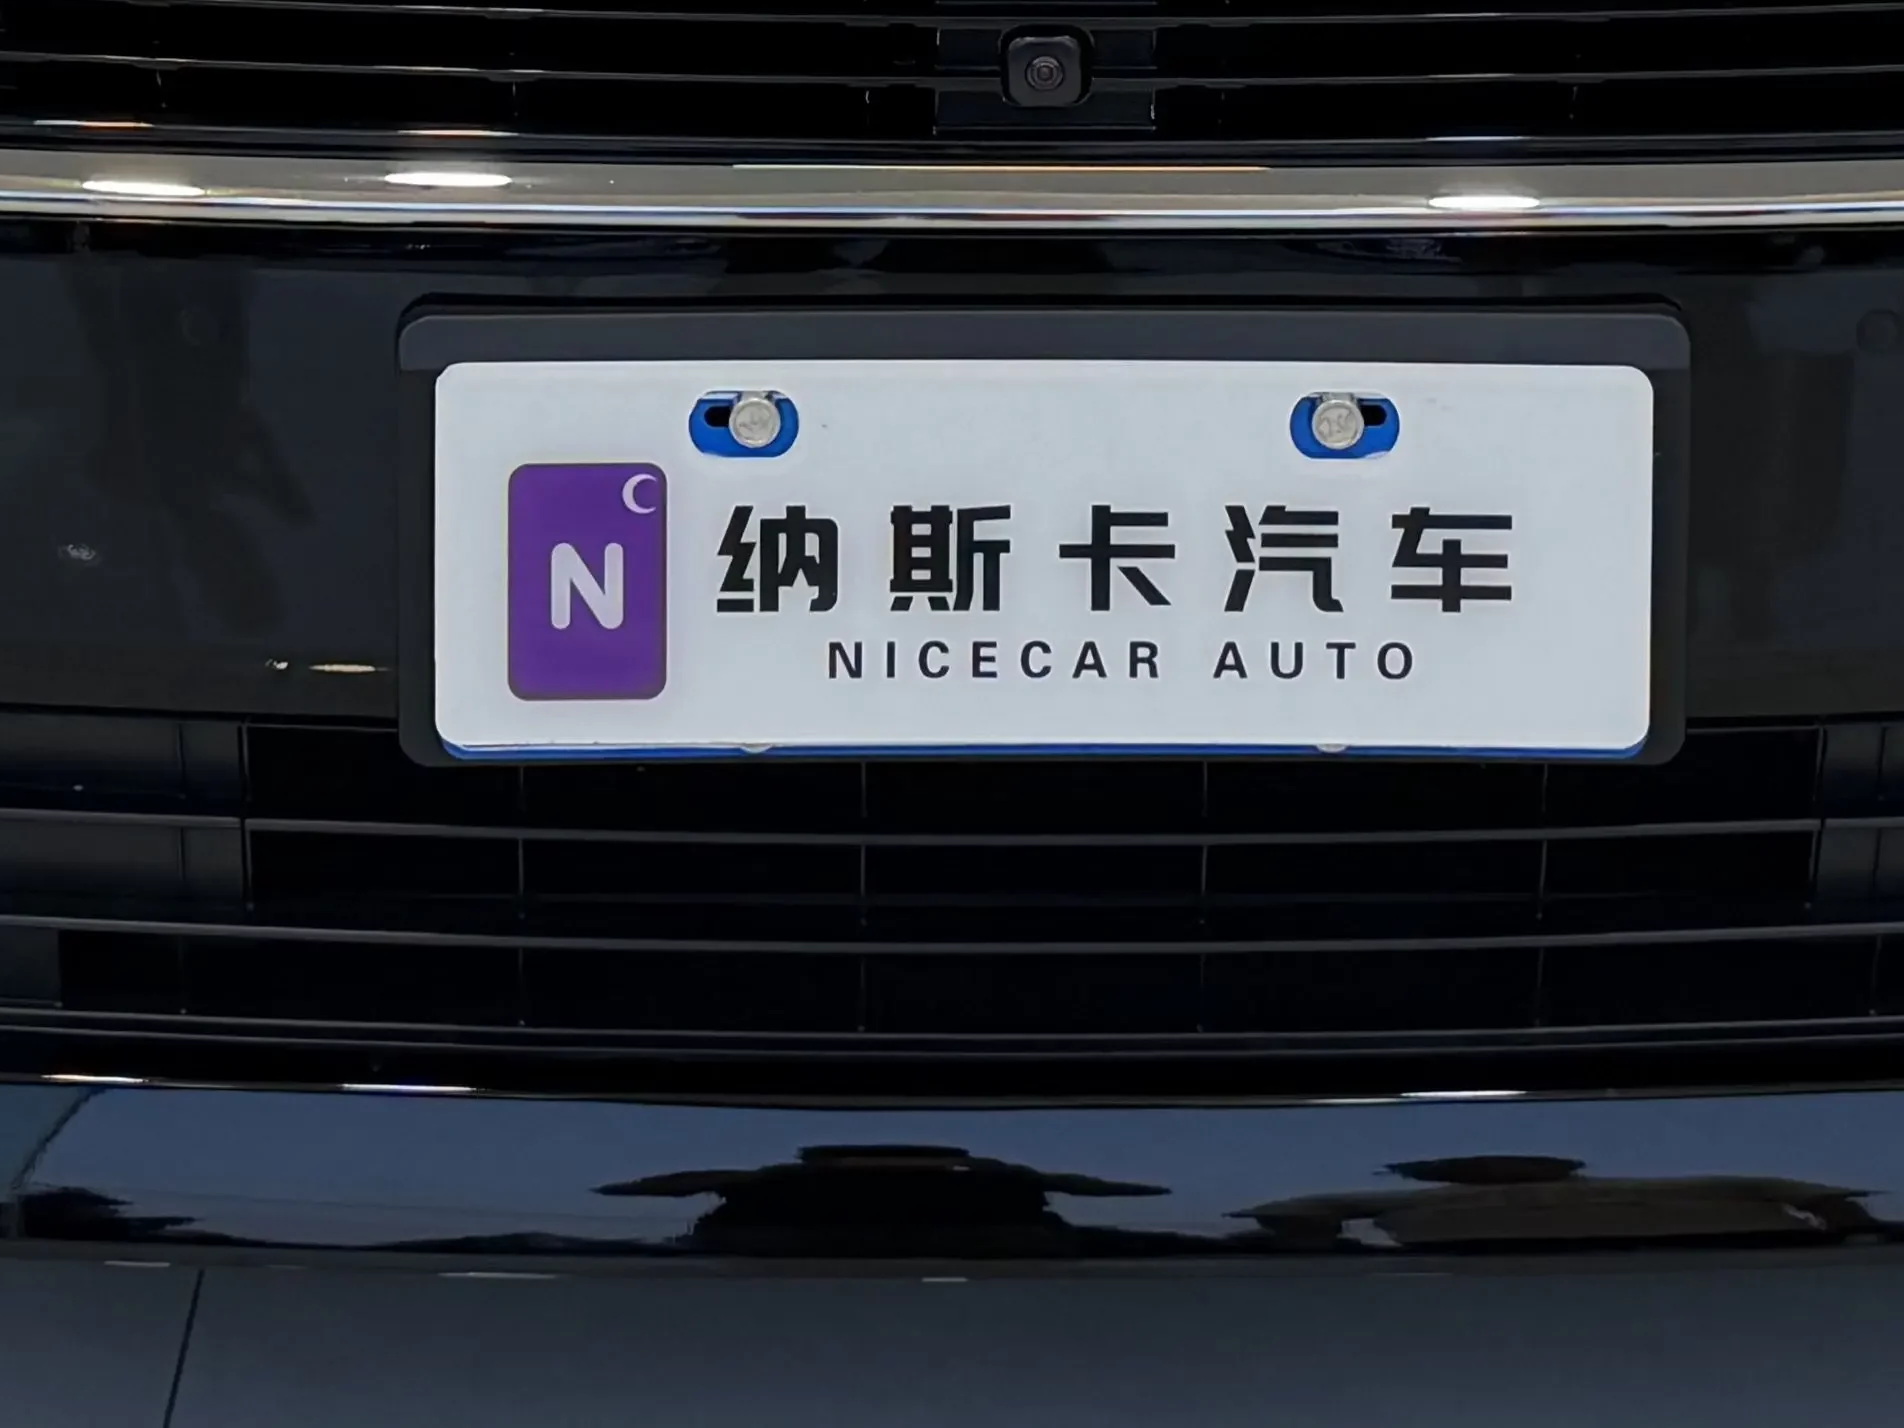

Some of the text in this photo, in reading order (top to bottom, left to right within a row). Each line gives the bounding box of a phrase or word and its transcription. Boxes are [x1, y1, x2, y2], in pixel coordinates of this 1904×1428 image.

[551, 542, 624, 630] N
[715, 503, 1515, 613] 纳斯卡汽车
[827, 639, 1417, 681] NICECAR AUTO
